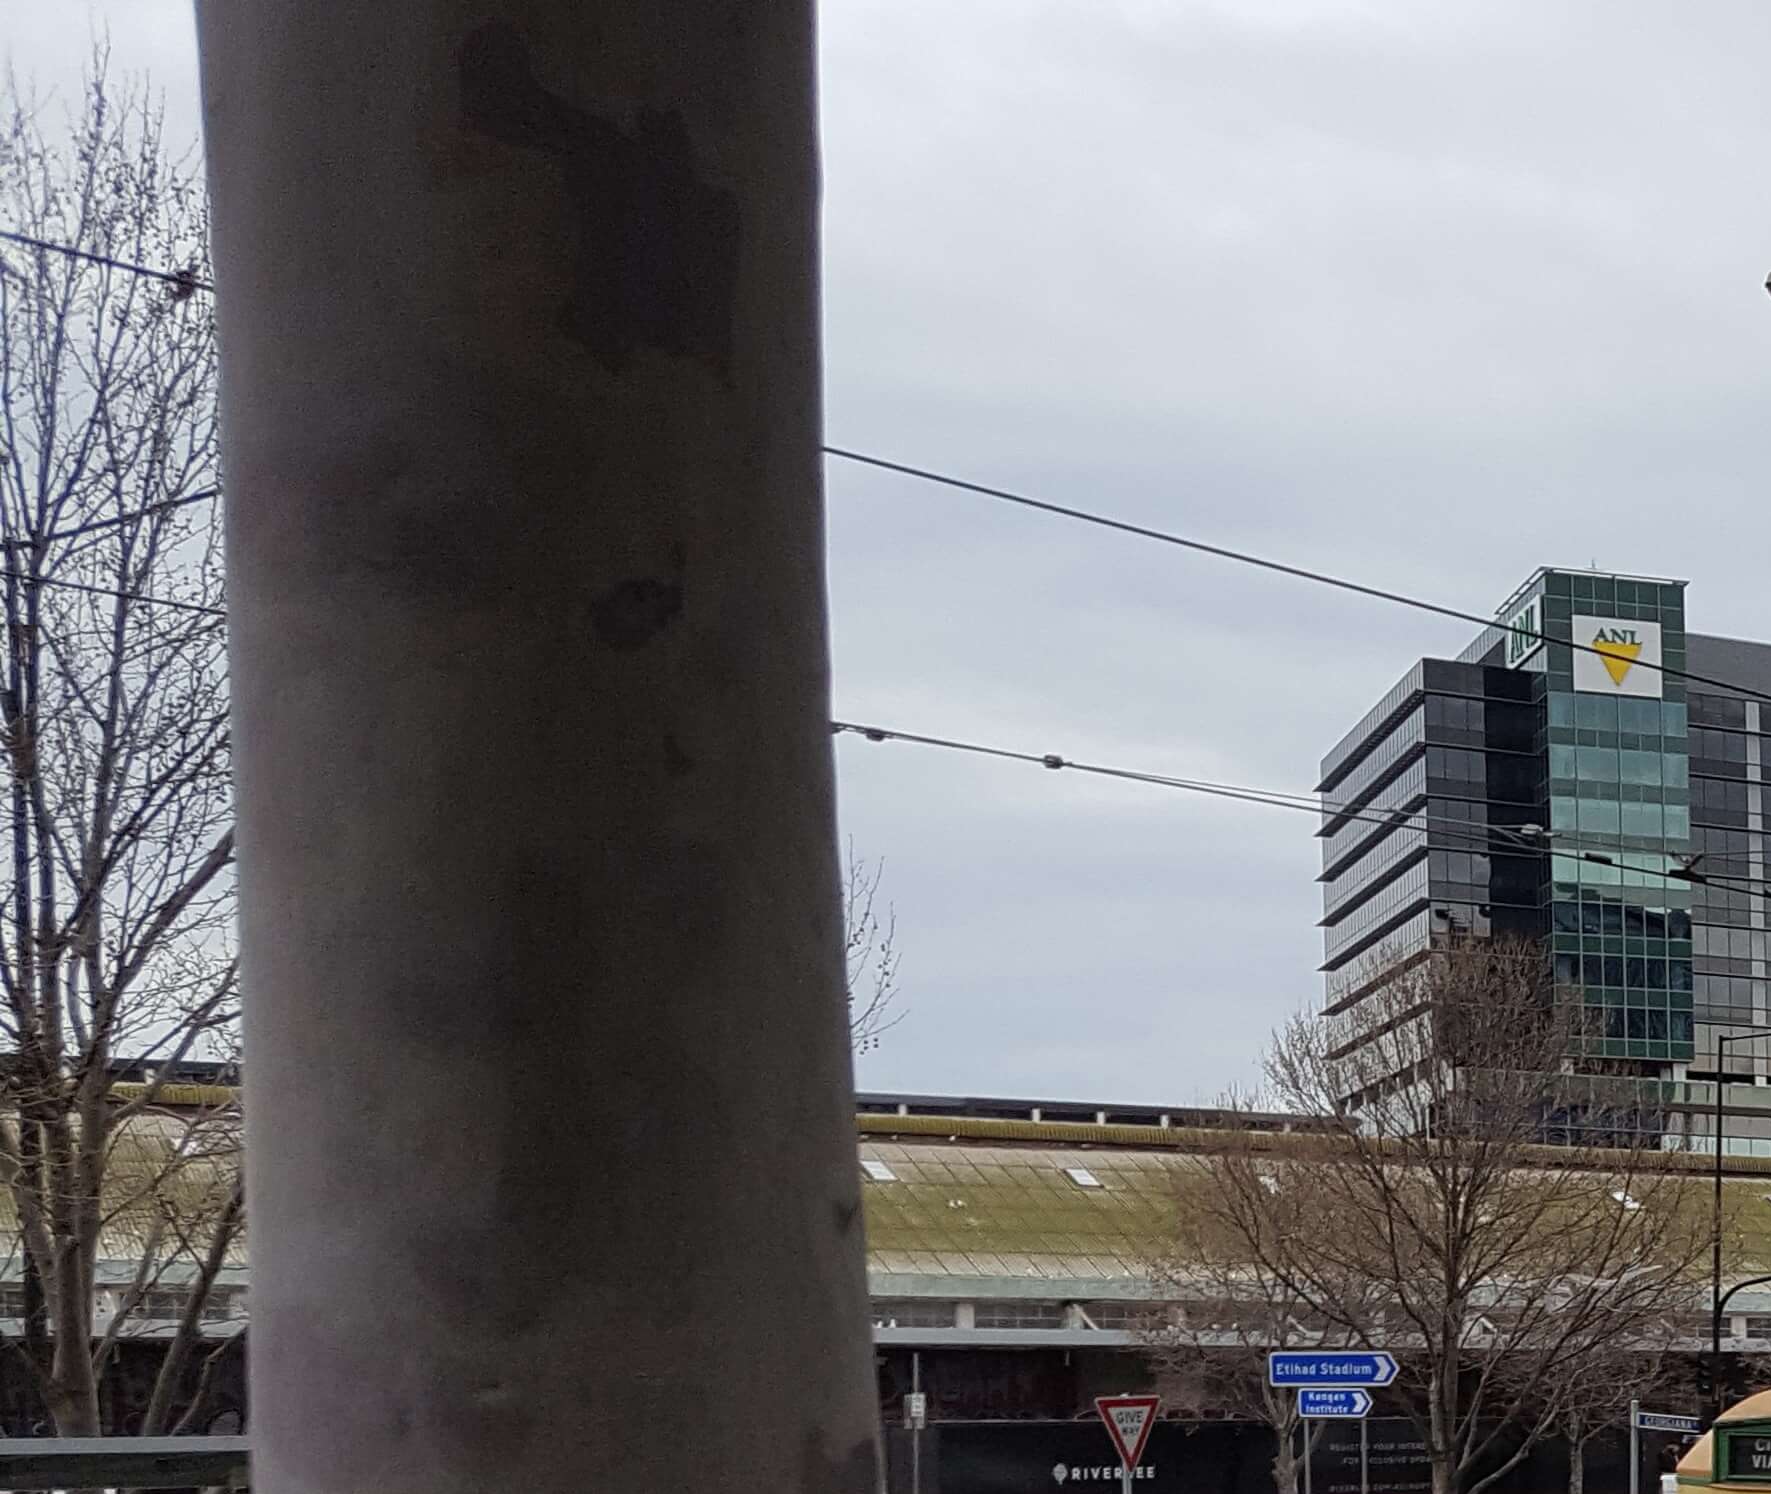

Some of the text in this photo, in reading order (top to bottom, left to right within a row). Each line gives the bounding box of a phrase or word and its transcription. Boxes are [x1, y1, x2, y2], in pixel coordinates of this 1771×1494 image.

[1510, 605, 1538, 663] ANL
[1592, 626, 1643, 646] ANL
[1275, 1363, 1373, 1376] Etihad Stadium
[1305, 1404, 1348, 1414] Institute
[1116, 1410, 1144, 1425] GIVE
[1071, 1466, 1156, 1481] RIVEREE
